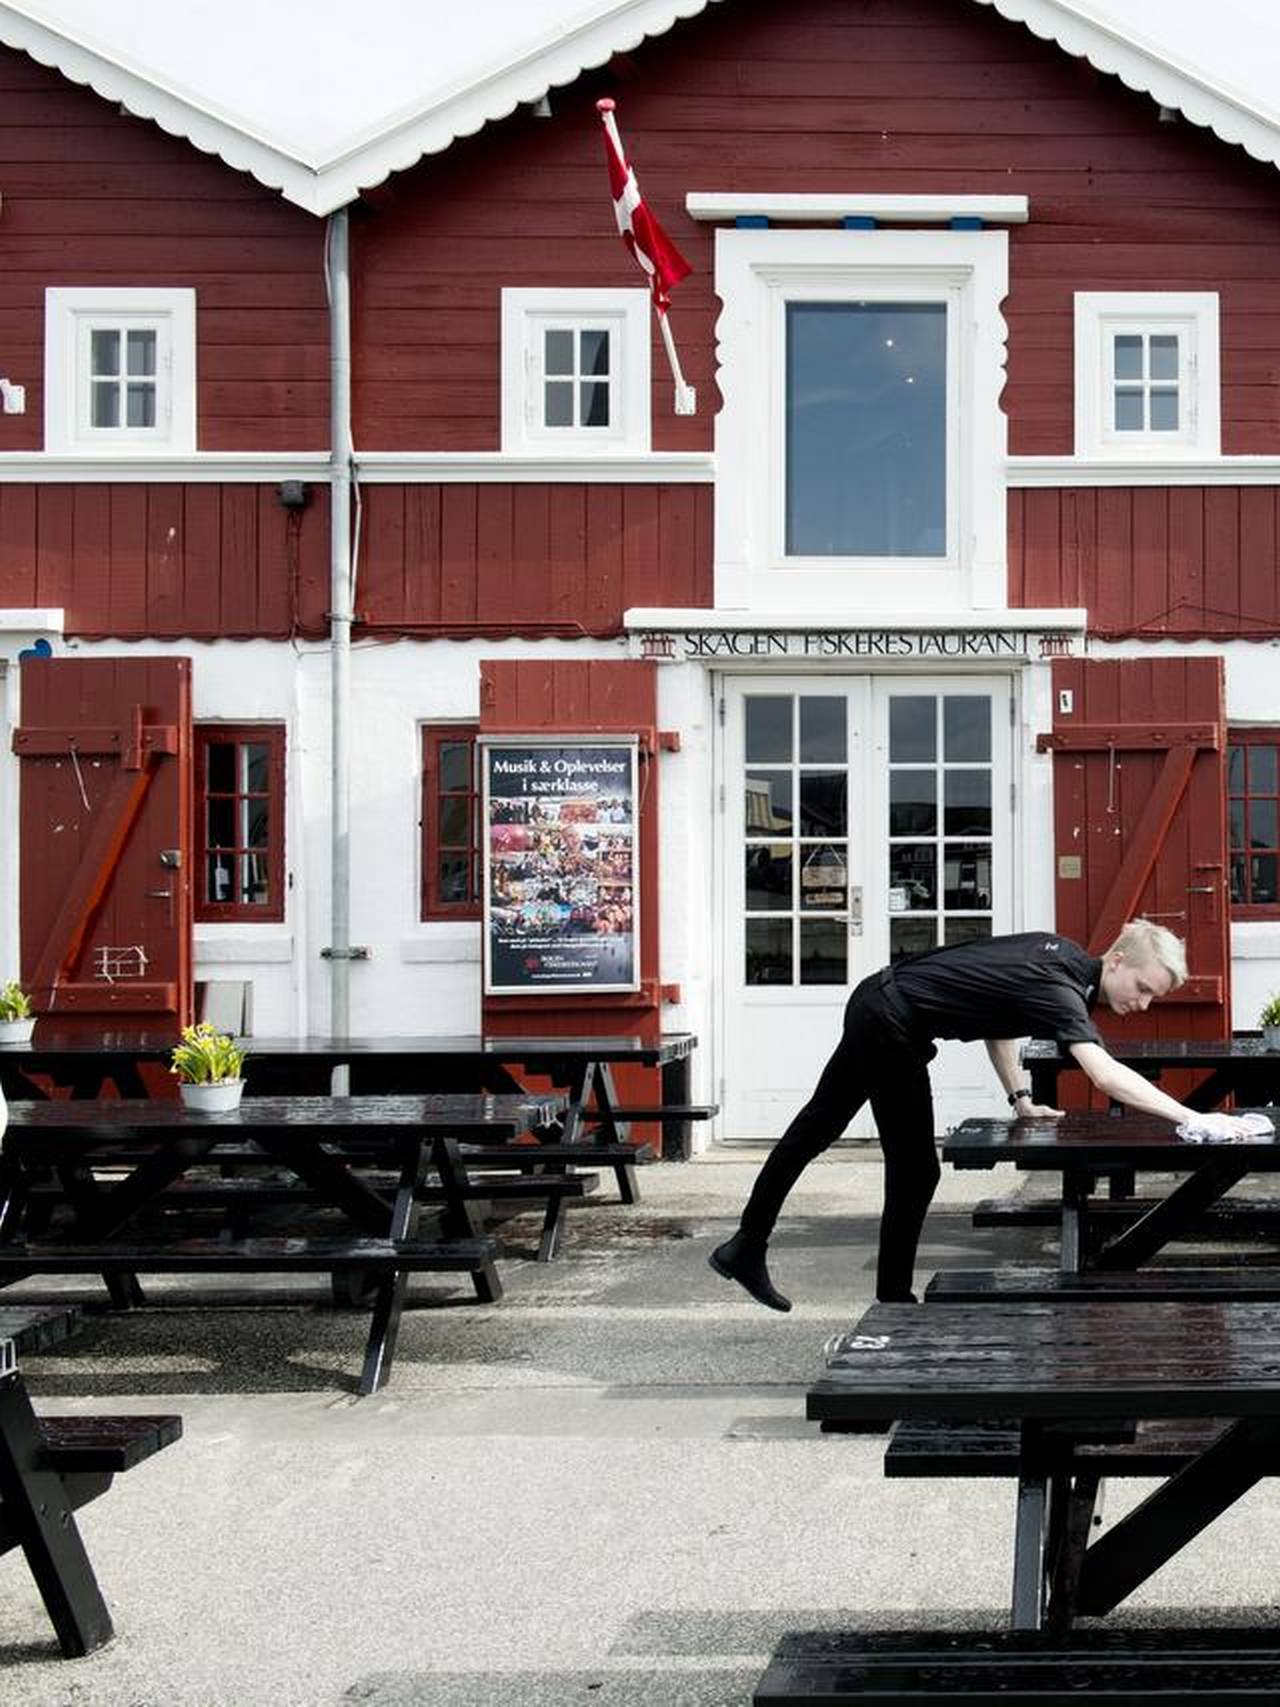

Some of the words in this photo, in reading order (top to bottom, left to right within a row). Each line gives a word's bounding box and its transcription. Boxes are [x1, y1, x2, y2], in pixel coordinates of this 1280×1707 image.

[684, 632, 789, 655] SKAGEN
[493, 759, 537, 773] Musik
[539, 760, 551, 773] &
[553, 759, 626, 777] Oplevelser
[531, 778, 599, 792] særklasse
